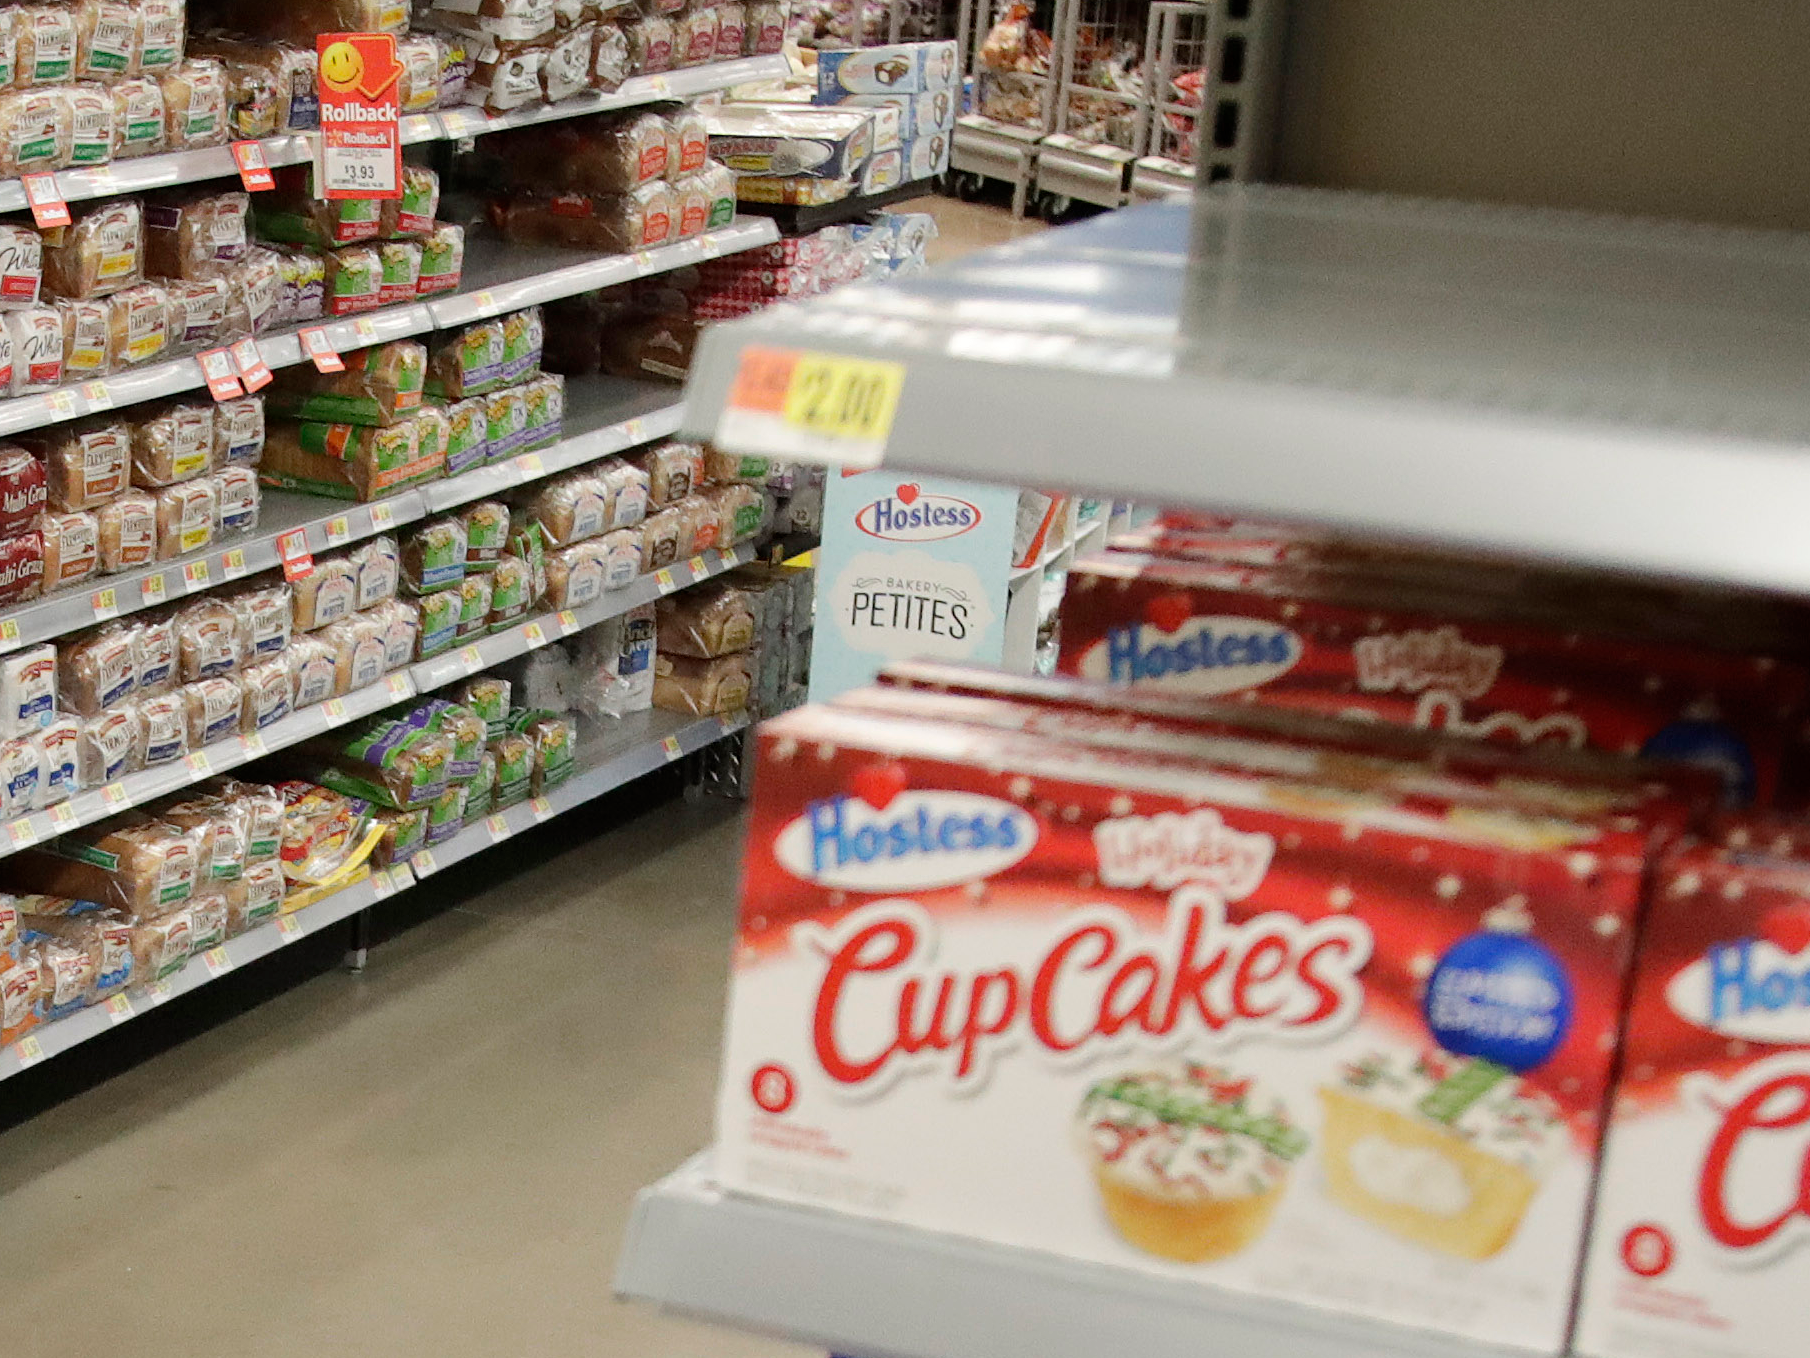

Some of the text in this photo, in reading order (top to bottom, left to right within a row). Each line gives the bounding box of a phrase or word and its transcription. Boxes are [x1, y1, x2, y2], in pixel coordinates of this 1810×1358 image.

[321, 102, 398, 122] Rollback
[343, 132, 388, 144] Rollback
[344, 165, 375, 179] $3.93
[873, 499, 973, 534] Hostess
[19, 558, 44, 579] Grain
[886, 576, 940, 594] BAKERY
[851, 593, 968, 641] PETITES
[1105, 627, 1290, 684] Hostess
[810, 807, 1021, 879] Hostess
[1101, 822, 1267, 888] Holiday
